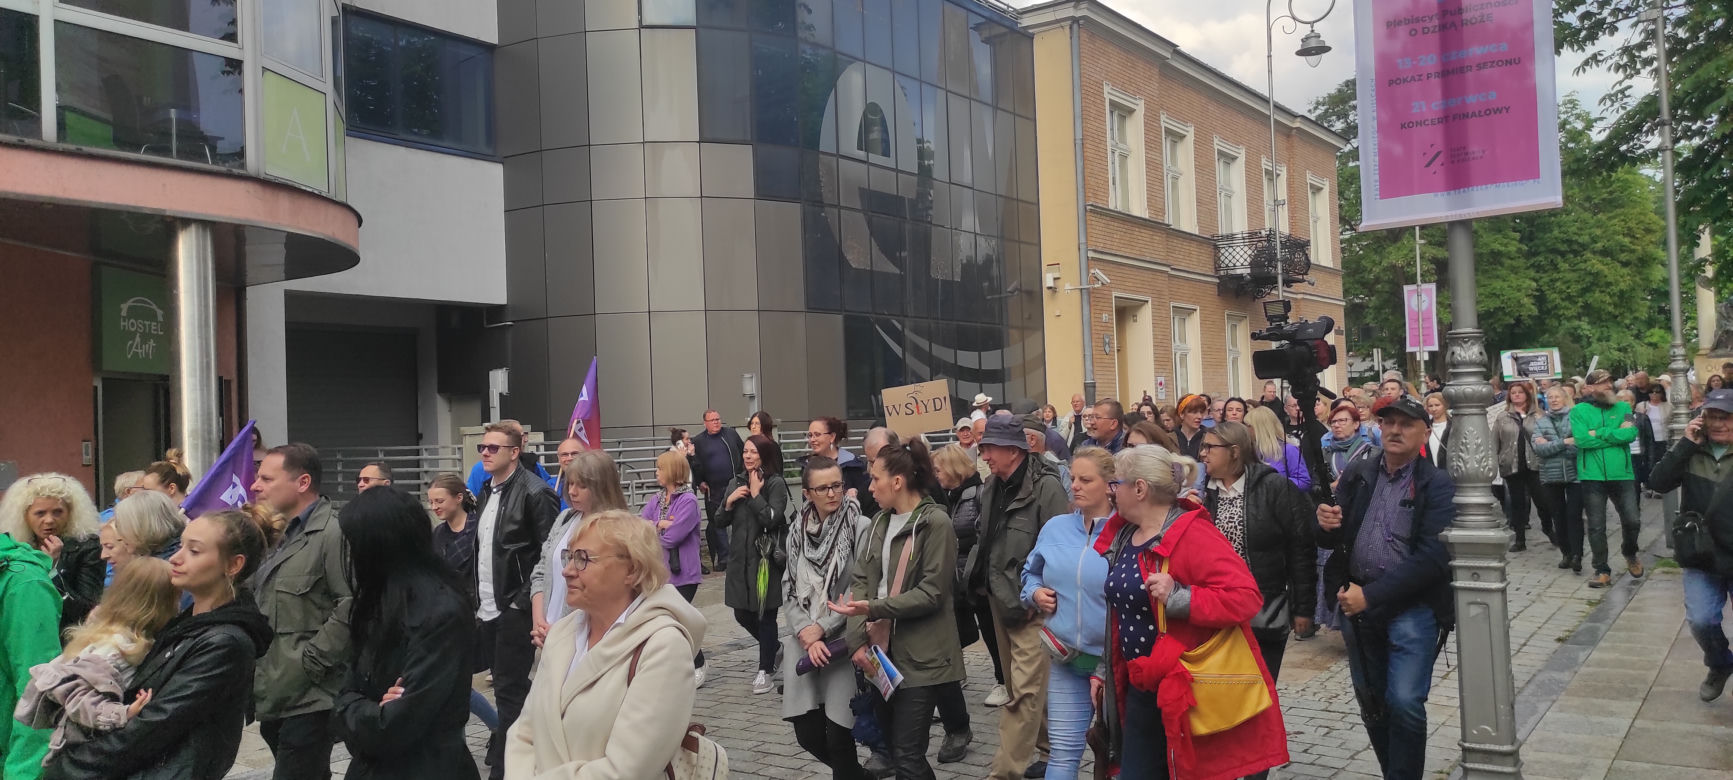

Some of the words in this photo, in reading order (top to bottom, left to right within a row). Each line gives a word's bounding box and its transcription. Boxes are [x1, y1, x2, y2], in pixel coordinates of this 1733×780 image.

[1409, 28, 1418, 37] O
[1442, 42, 1508, 62] czerwca
[1388, 74, 1423, 87] POKAZ
[1426, 65, 1473, 81] PREMIER
[1476, 57, 1521, 71] SEZONU
[1411, 101, 1426, 114] 21
[1431, 90, 1497, 109] czerwca
[1400, 115, 1450, 130] KONCERT
[1452, 105, 1511, 122] FINAŁOWY
[281, 105, 312, 163] A
[120, 316, 164, 335] HOSTEL
